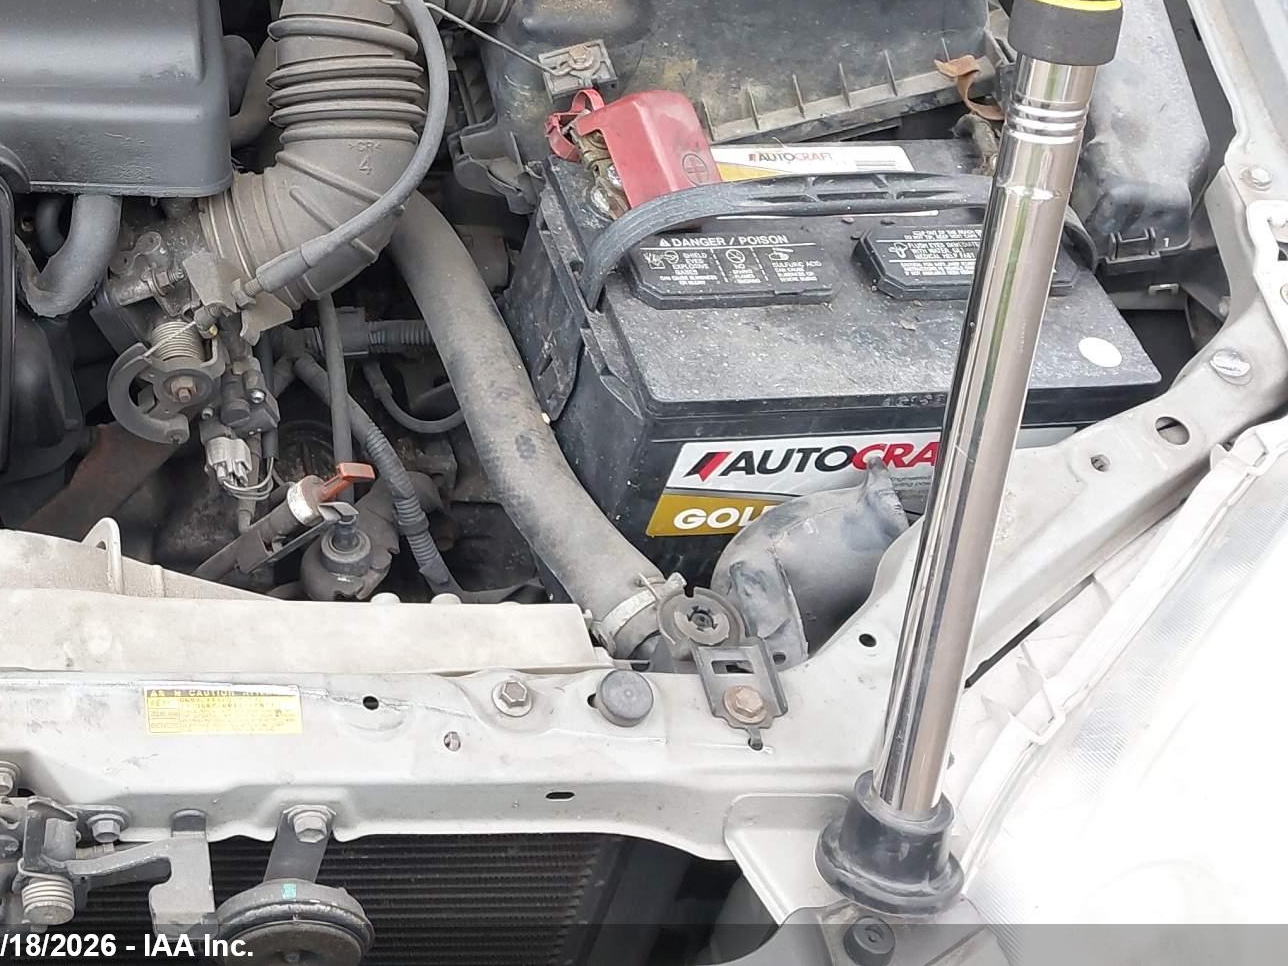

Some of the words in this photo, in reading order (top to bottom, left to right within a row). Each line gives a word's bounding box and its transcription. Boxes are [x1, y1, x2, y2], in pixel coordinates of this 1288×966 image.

[758, 152, 832, 162] AUTOCRAFT
[671, 237, 725, 247] DANGER
[729, 236, 736, 245] /
[739, 235, 789, 245] POISON
[718, 442, 940, 477] AUTOCRA
